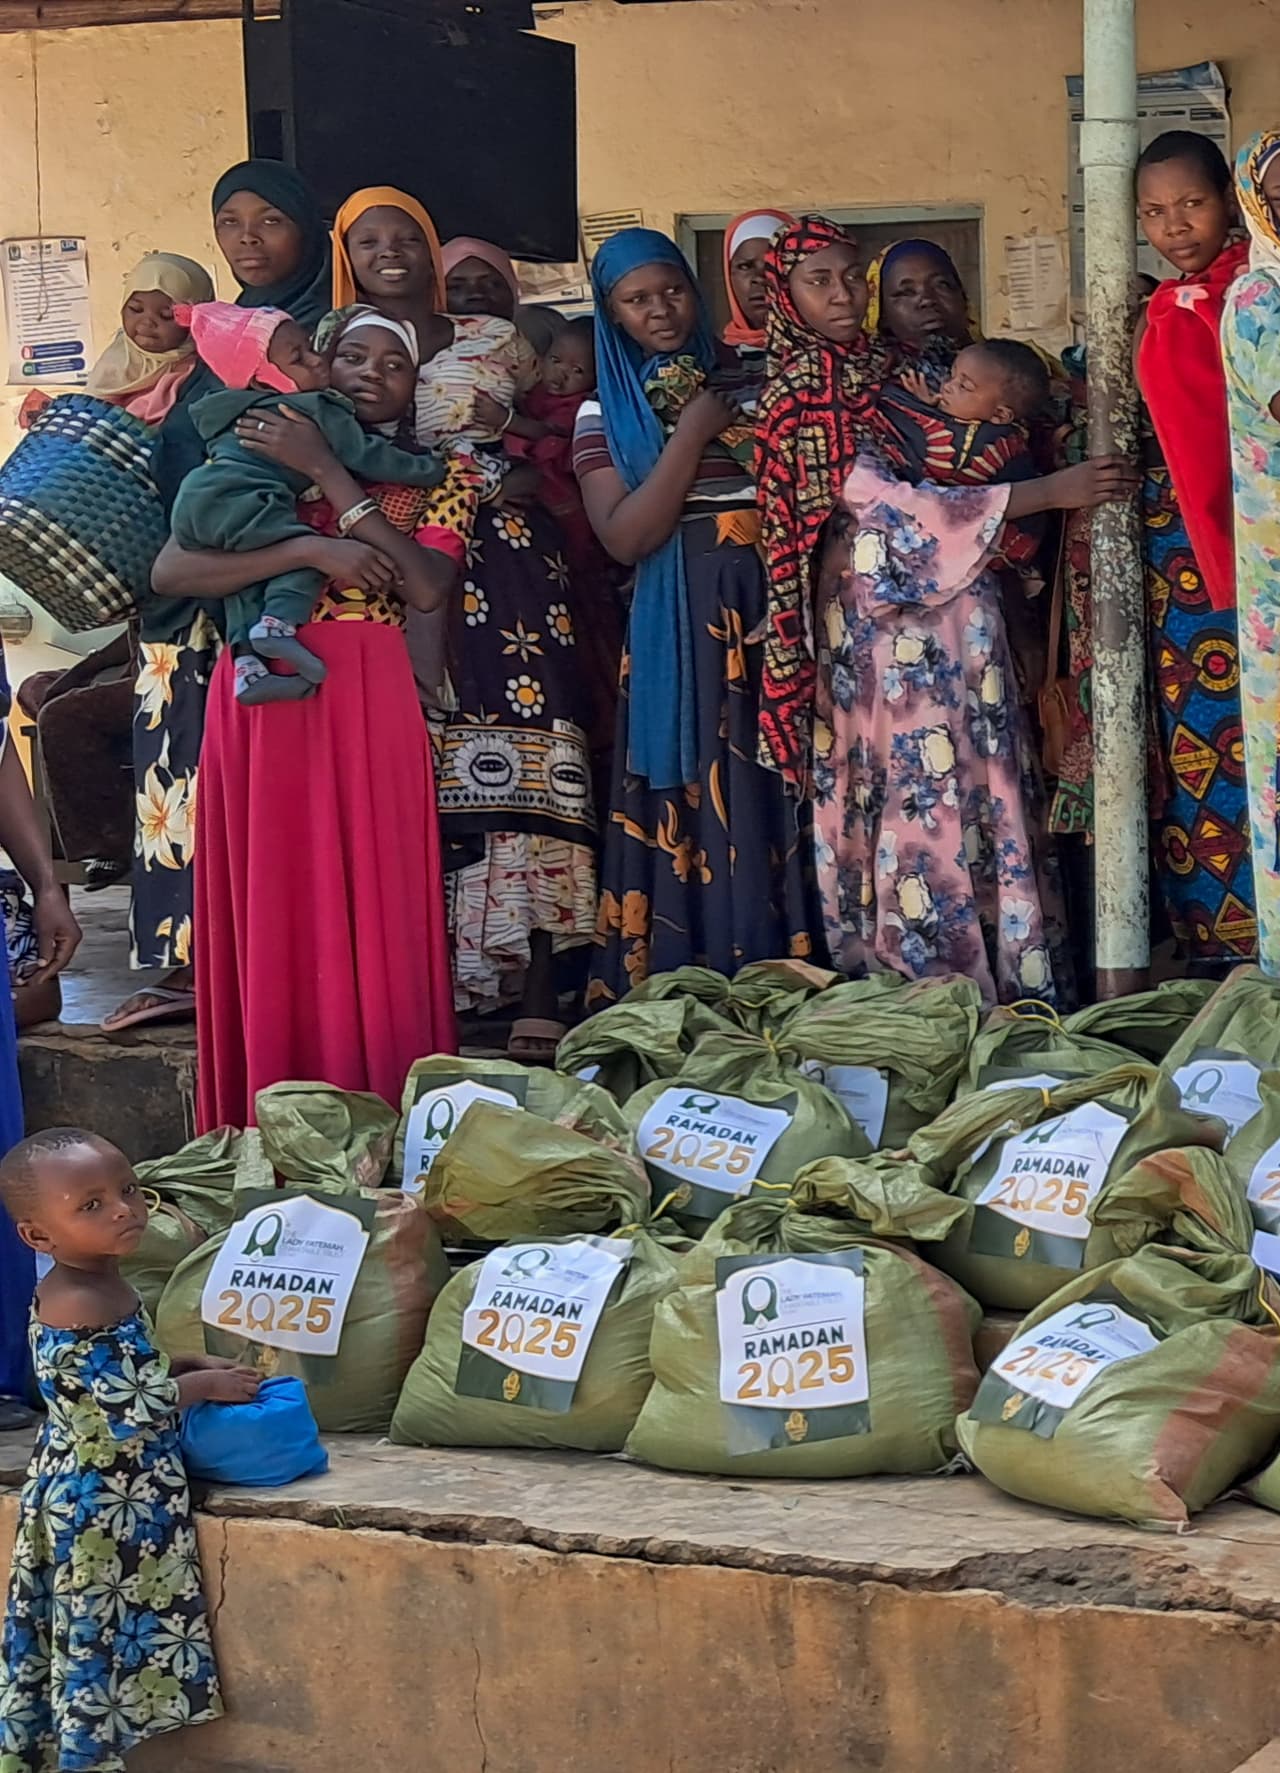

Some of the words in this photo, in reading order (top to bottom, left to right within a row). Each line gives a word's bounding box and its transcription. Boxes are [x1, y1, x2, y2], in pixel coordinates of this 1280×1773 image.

[665, 1114, 759, 1146] RAMADAN
[645, 1127, 758, 1175] 2025
[1011, 1157, 1091, 1179] RAMADAN
[985, 1174, 1090, 1217] 2025
[230, 1269, 334, 1295] RAMADAN
[217, 1289, 337, 1334] 2025
[488, 1290, 583, 1321] RAMADAN
[476, 1308, 583, 1358] 2025
[744, 1325, 844, 1360] RAMADAN
[737, 1344, 855, 1399] 2025
